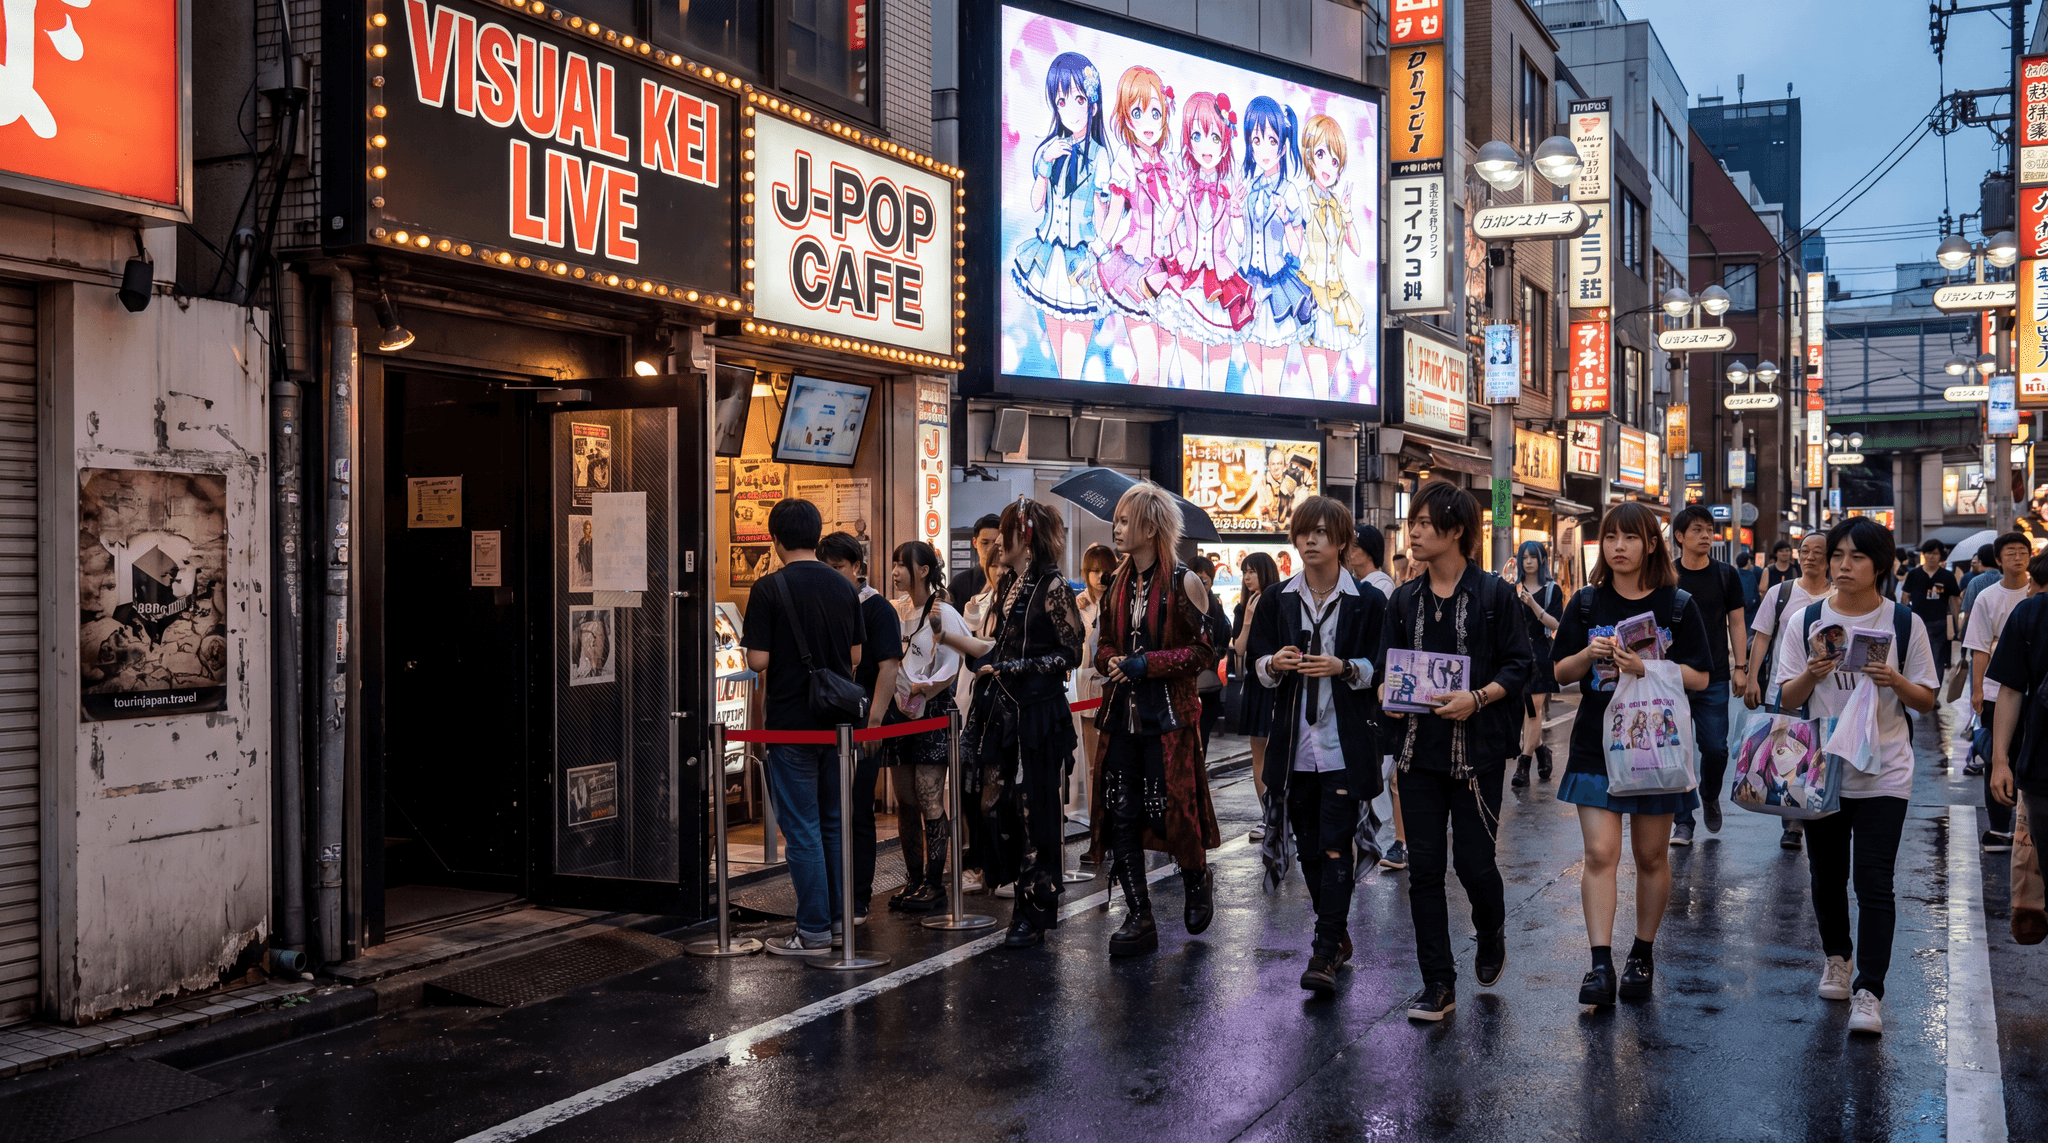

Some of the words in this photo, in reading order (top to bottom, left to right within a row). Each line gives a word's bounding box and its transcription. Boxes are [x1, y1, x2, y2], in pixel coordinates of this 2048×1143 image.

[405, 0, 630, 162] VISUAL
[640, 77, 720, 188] KEI
[509, 138, 639, 265] LIVE
[772, 148, 936, 258] J-POP
[790, 234, 924, 332] CAFE
[114, 692, 197, 708] tourinjapan.travel
